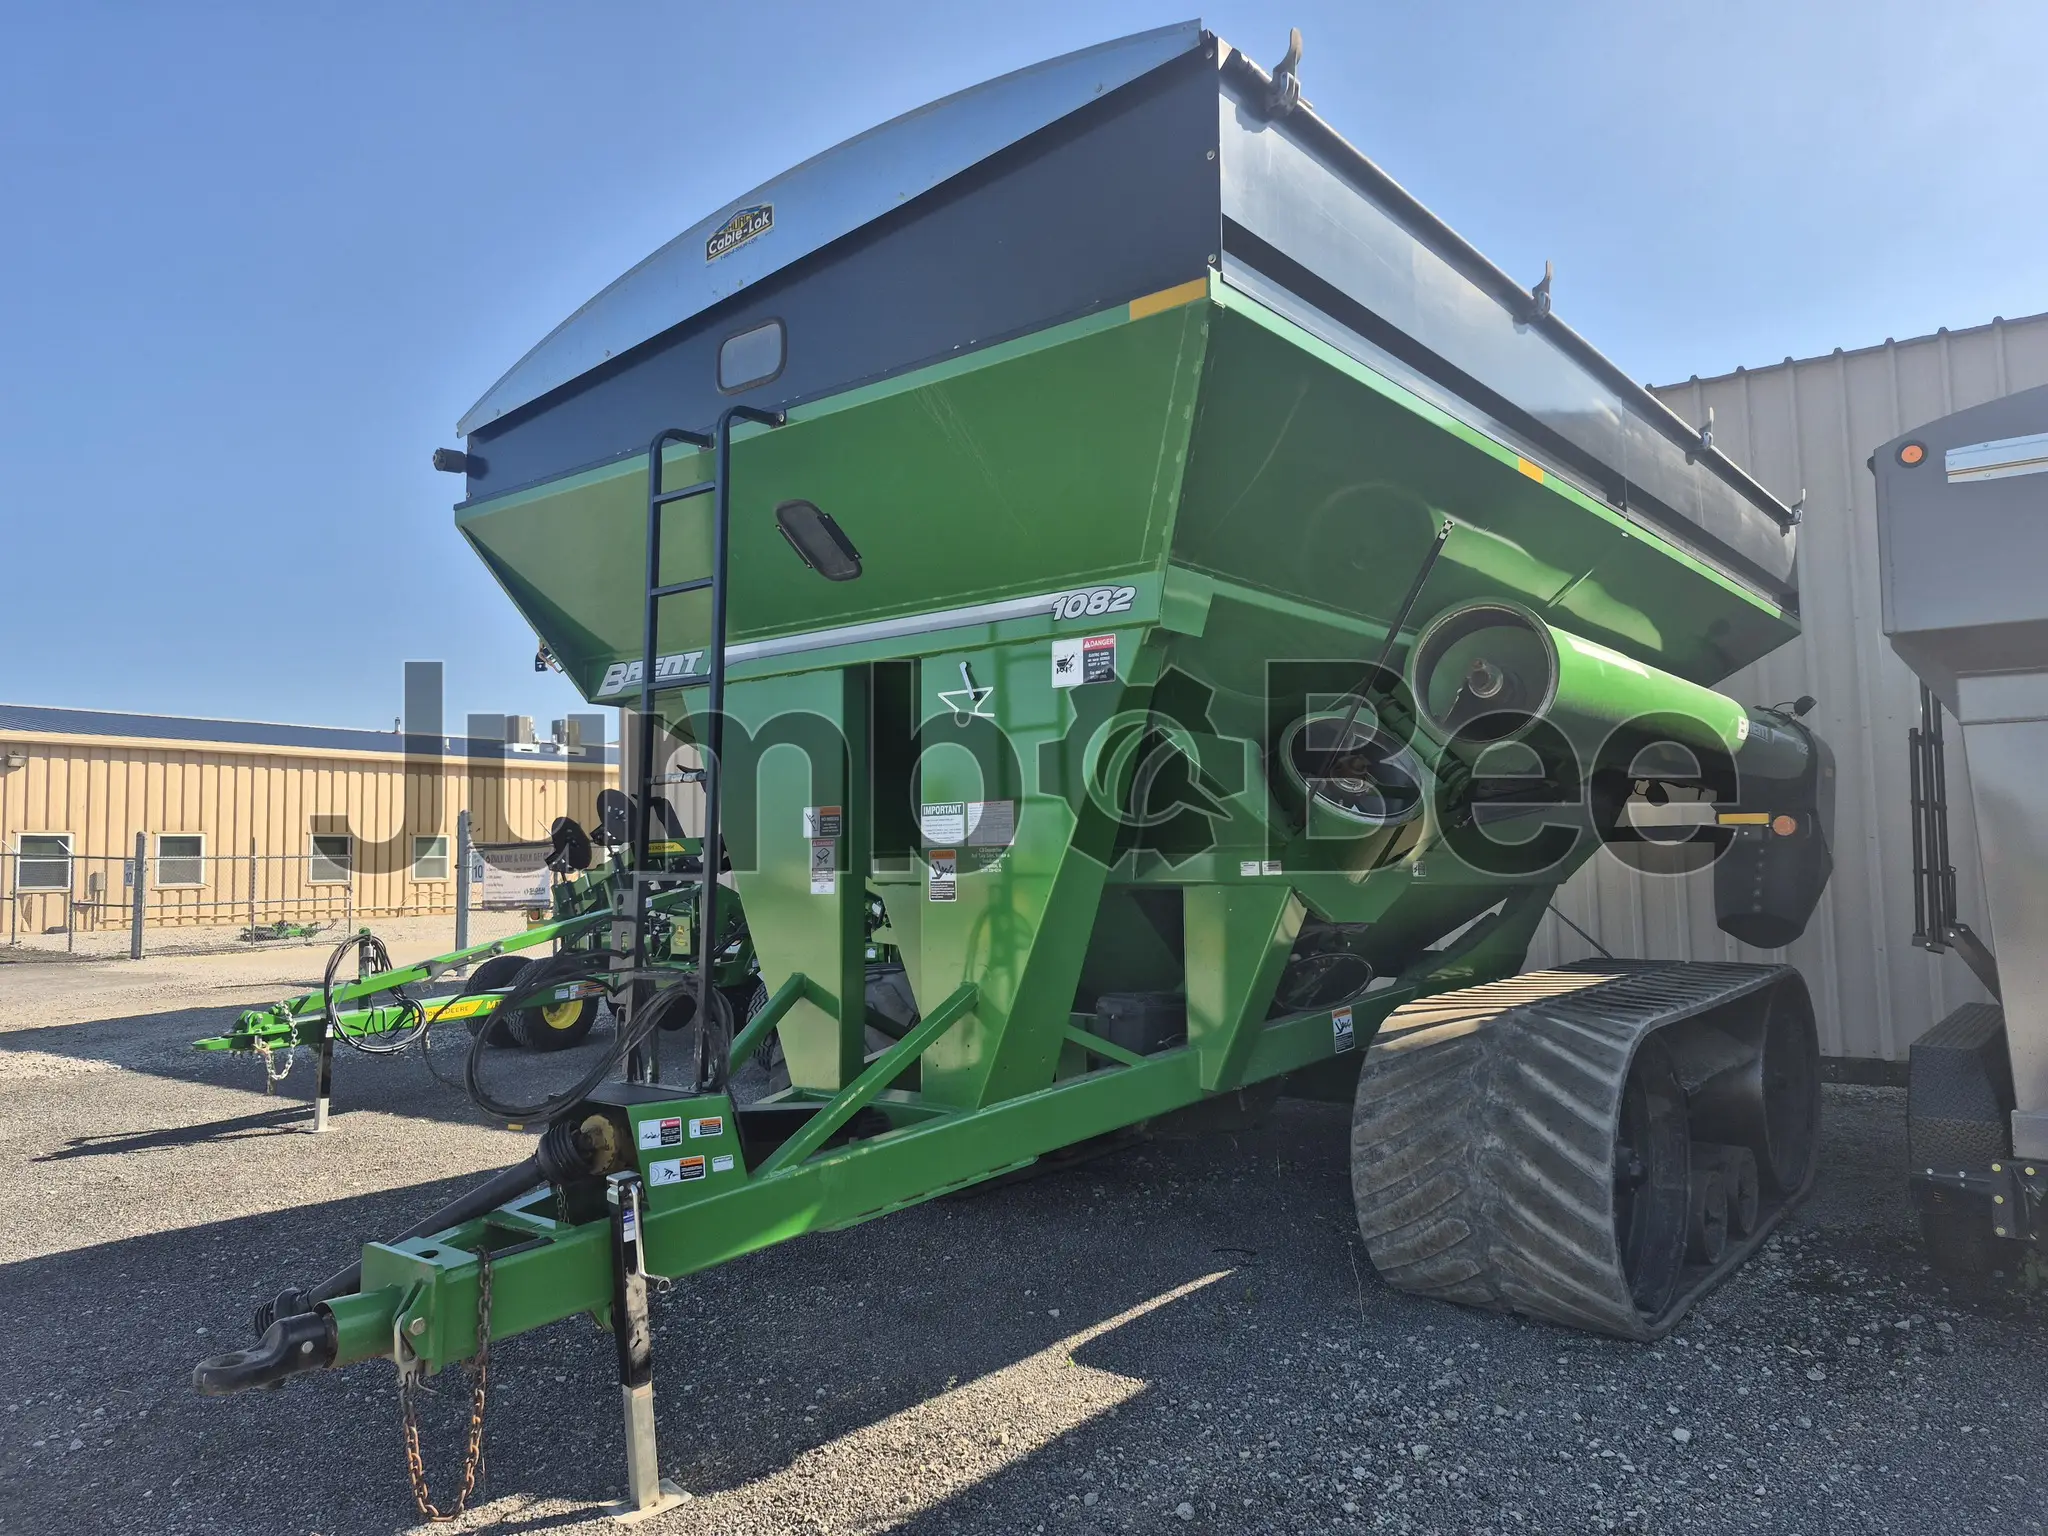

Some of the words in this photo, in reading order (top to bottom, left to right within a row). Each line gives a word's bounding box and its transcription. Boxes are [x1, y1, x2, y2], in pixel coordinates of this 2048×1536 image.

[708, 211, 770, 254] Cable-Lok
[1052, 586, 1137, 621] 1082
[1089, 637, 1114, 647] DANGER
[923, 804, 962, 816] IMPORTANT
[474, 865, 483, 879] 10
[445, 1006, 469, 1014] DEERE
